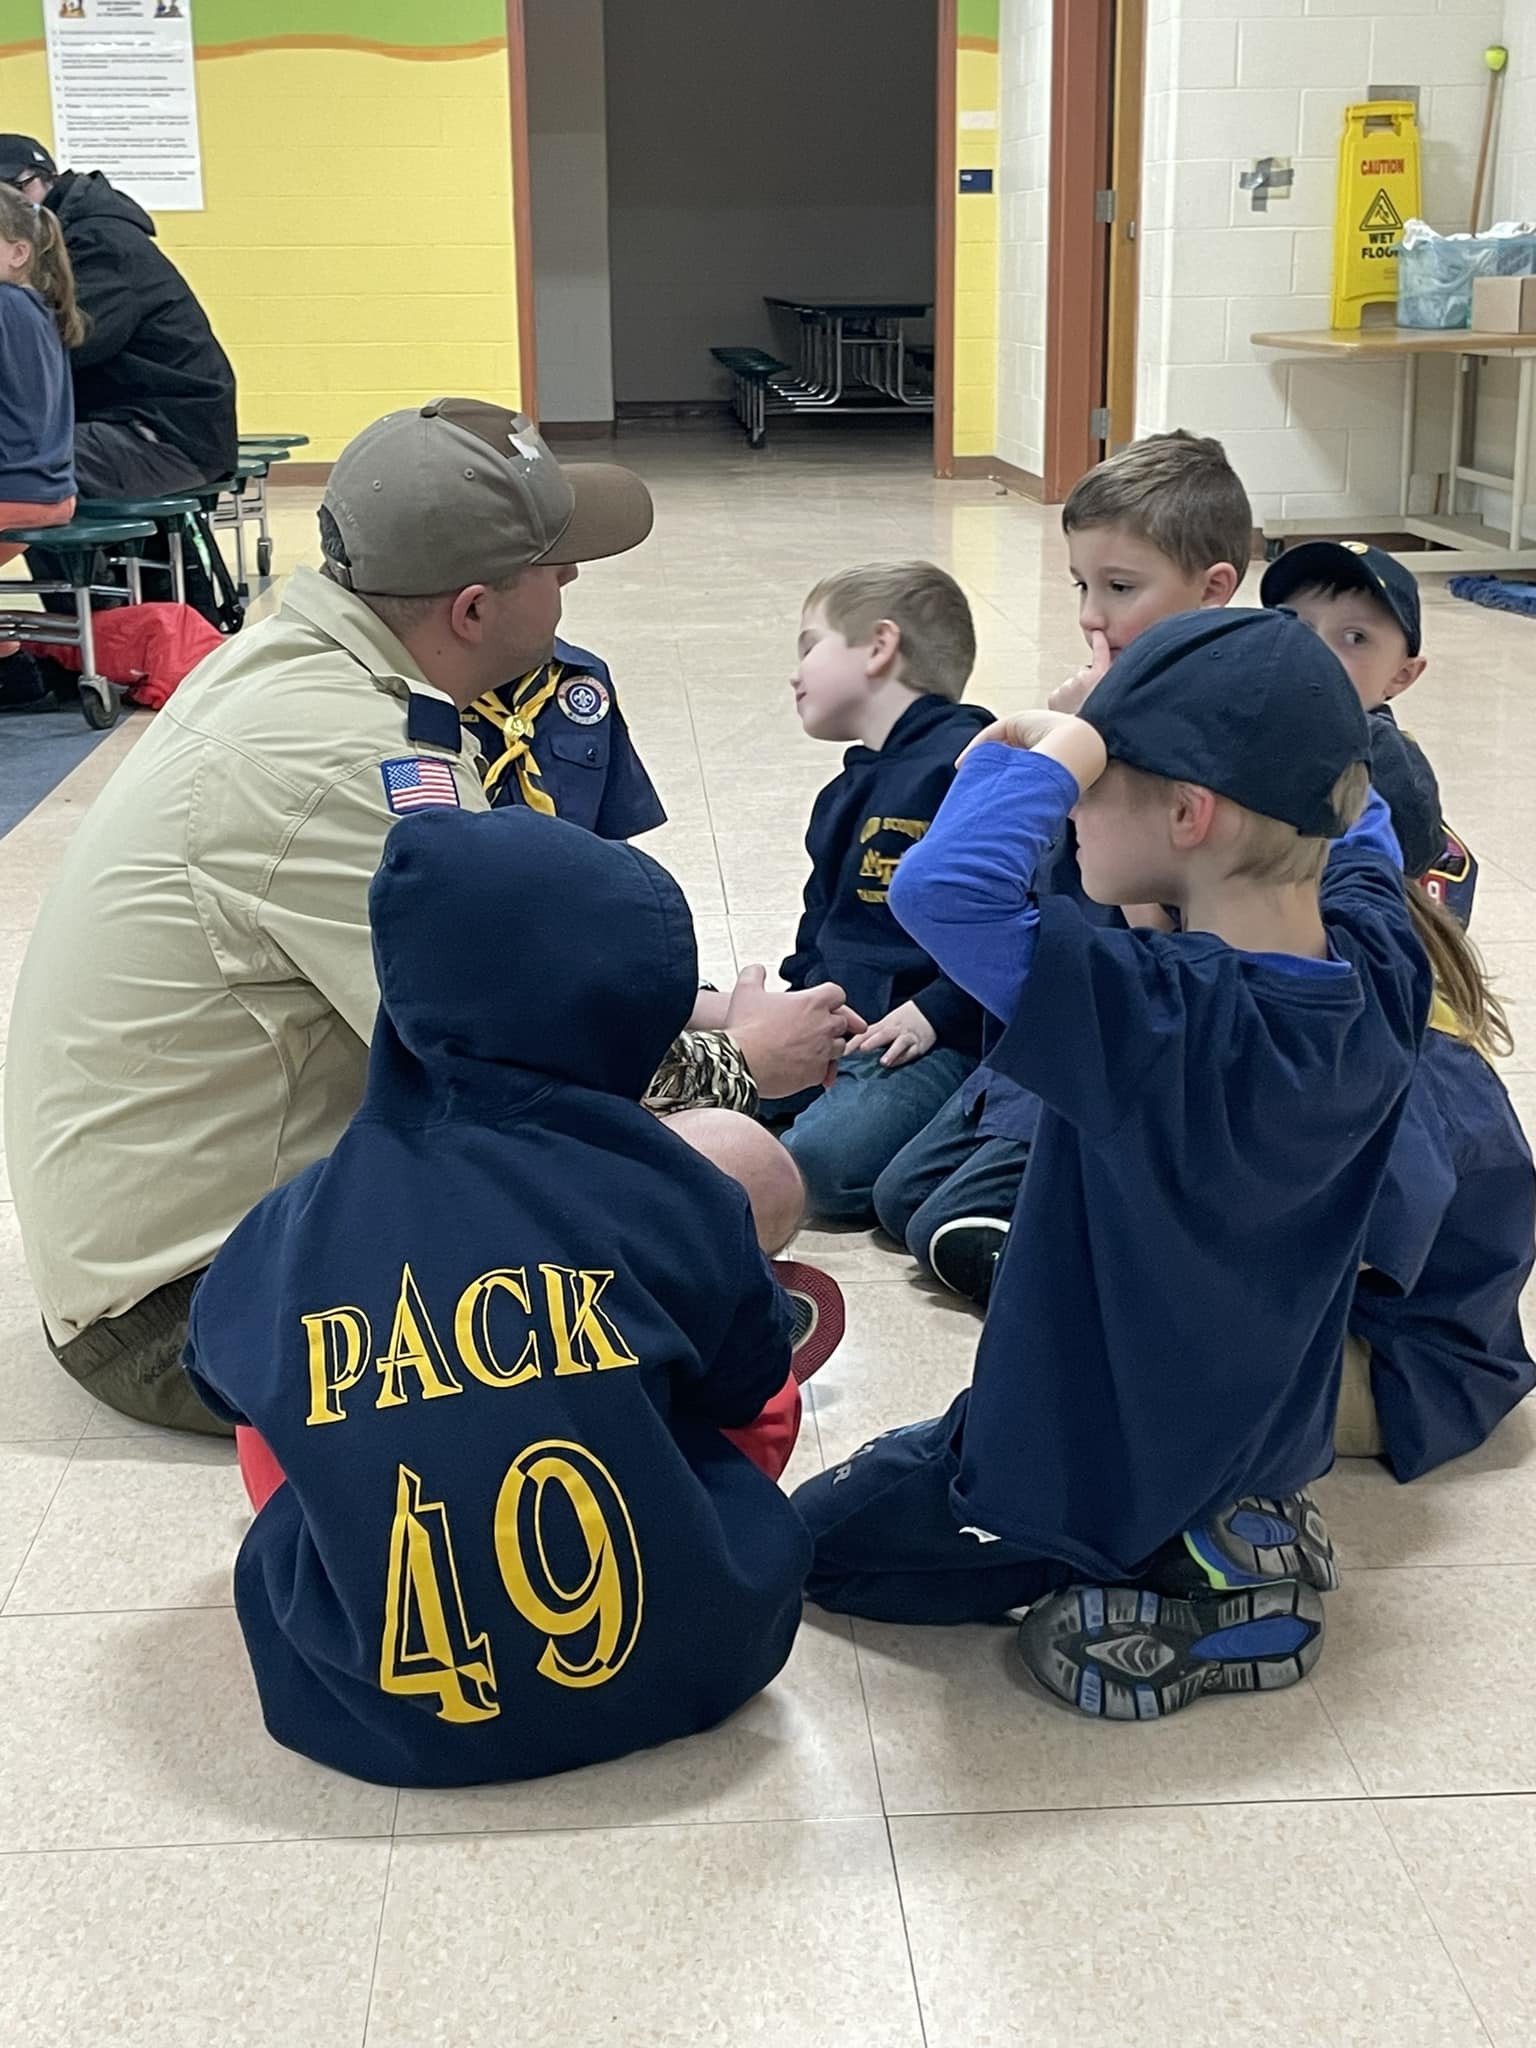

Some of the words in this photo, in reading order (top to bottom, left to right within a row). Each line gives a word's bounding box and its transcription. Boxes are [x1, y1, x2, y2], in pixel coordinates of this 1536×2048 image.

[1361, 159, 1404, 175] CAUTION
[1369, 232, 1395, 244] WET
[301, 1263, 640, 1426] PACK
[380, 1439, 643, 1723] 49
